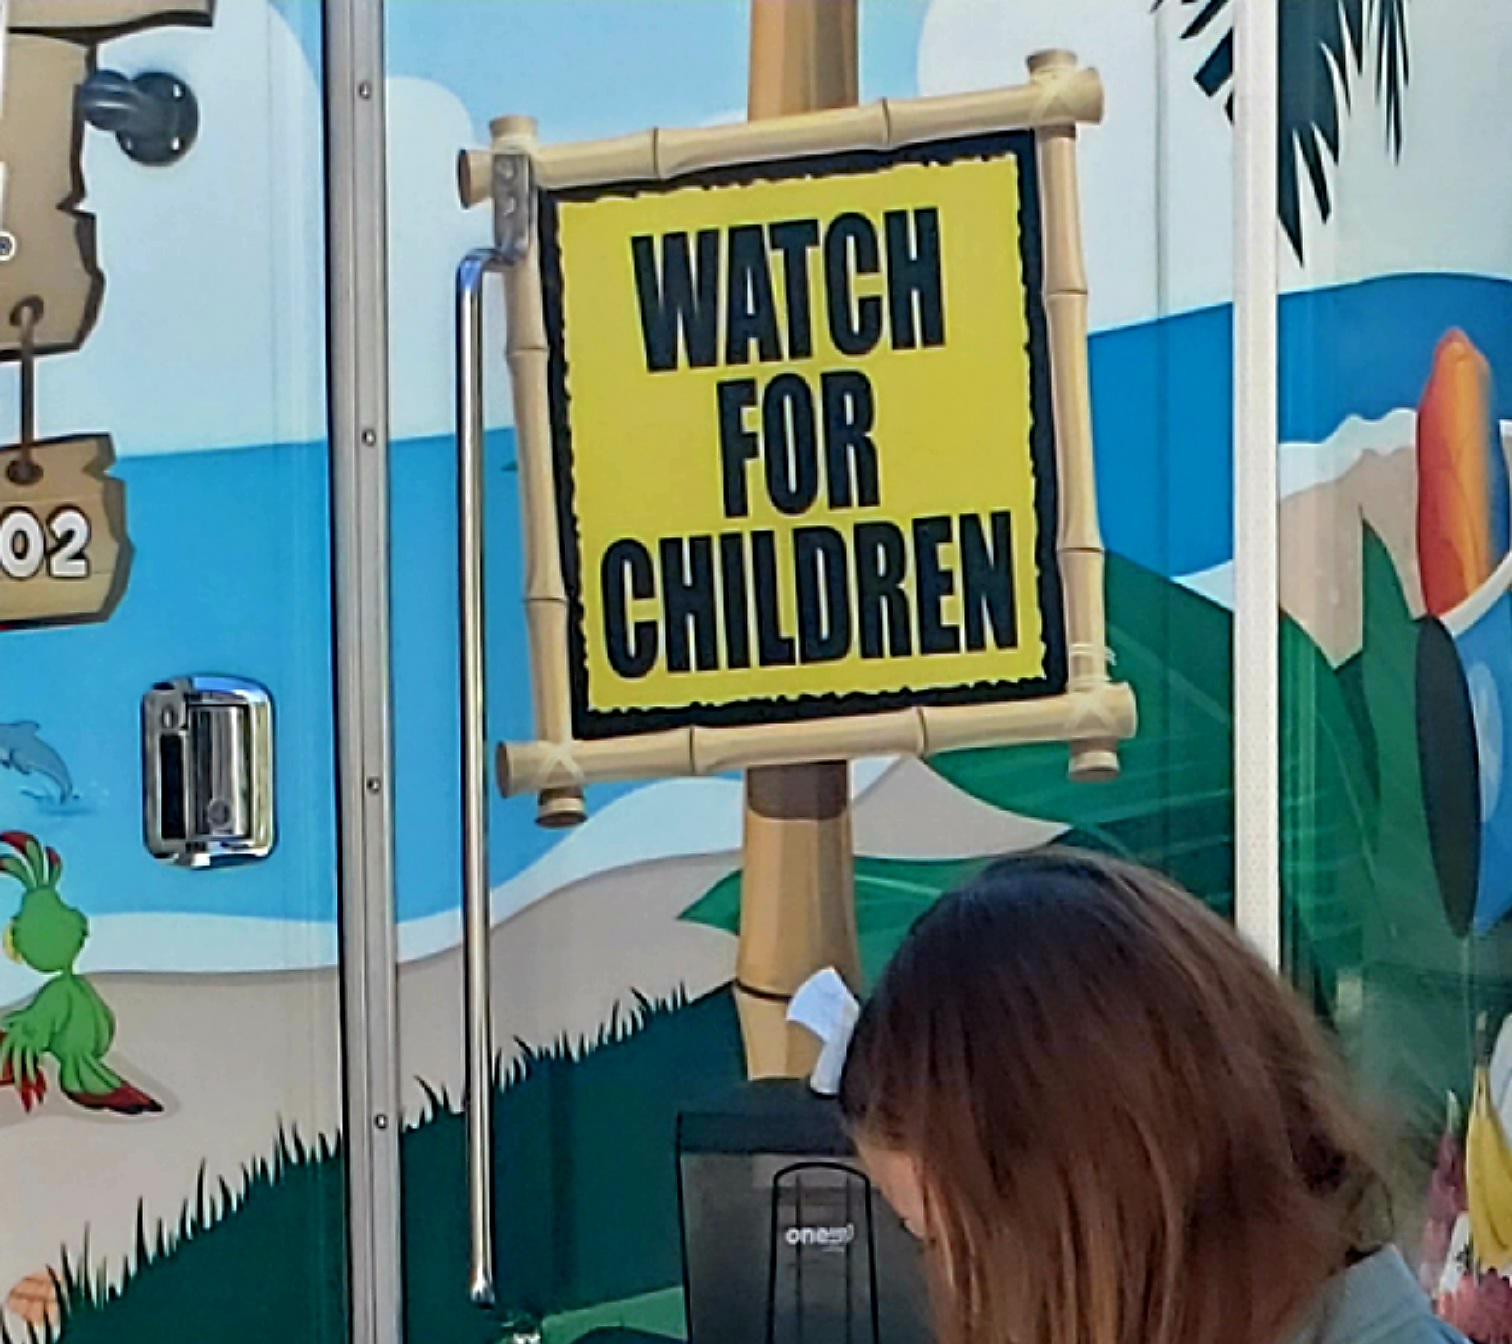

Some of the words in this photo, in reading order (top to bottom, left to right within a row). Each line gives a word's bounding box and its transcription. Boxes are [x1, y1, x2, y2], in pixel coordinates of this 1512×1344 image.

[630, 207, 946, 373] WATCH
[716, 369, 880, 518] FOR
[600, 510, 1018, 678] CHILDREN
